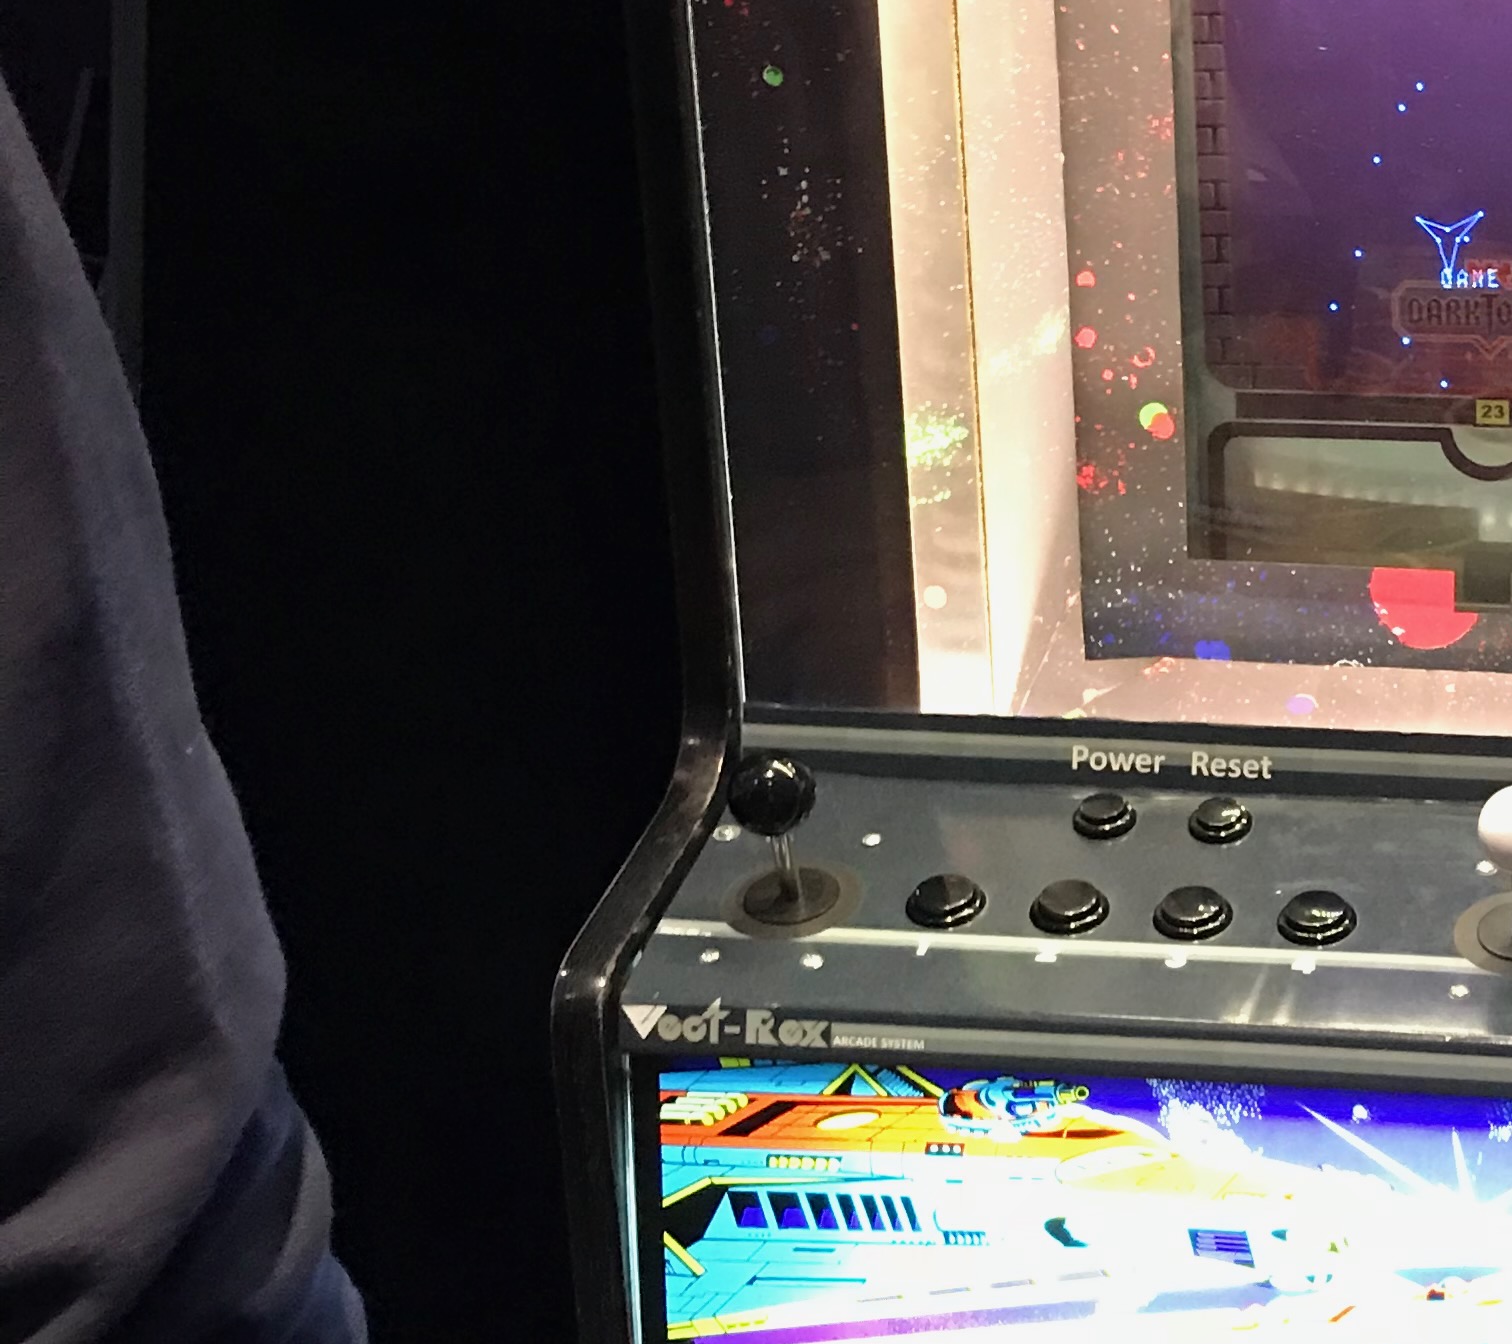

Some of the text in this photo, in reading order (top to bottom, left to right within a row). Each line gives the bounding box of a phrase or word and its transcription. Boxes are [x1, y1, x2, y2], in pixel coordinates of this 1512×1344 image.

[1440, 267, 1500, 289] GAME
[1481, 404, 1505, 419] 23
[1071, 744, 1273, 780] Power Reset
[621, 997, 926, 1051] Vect-Rex ARCADE SYSTEM
